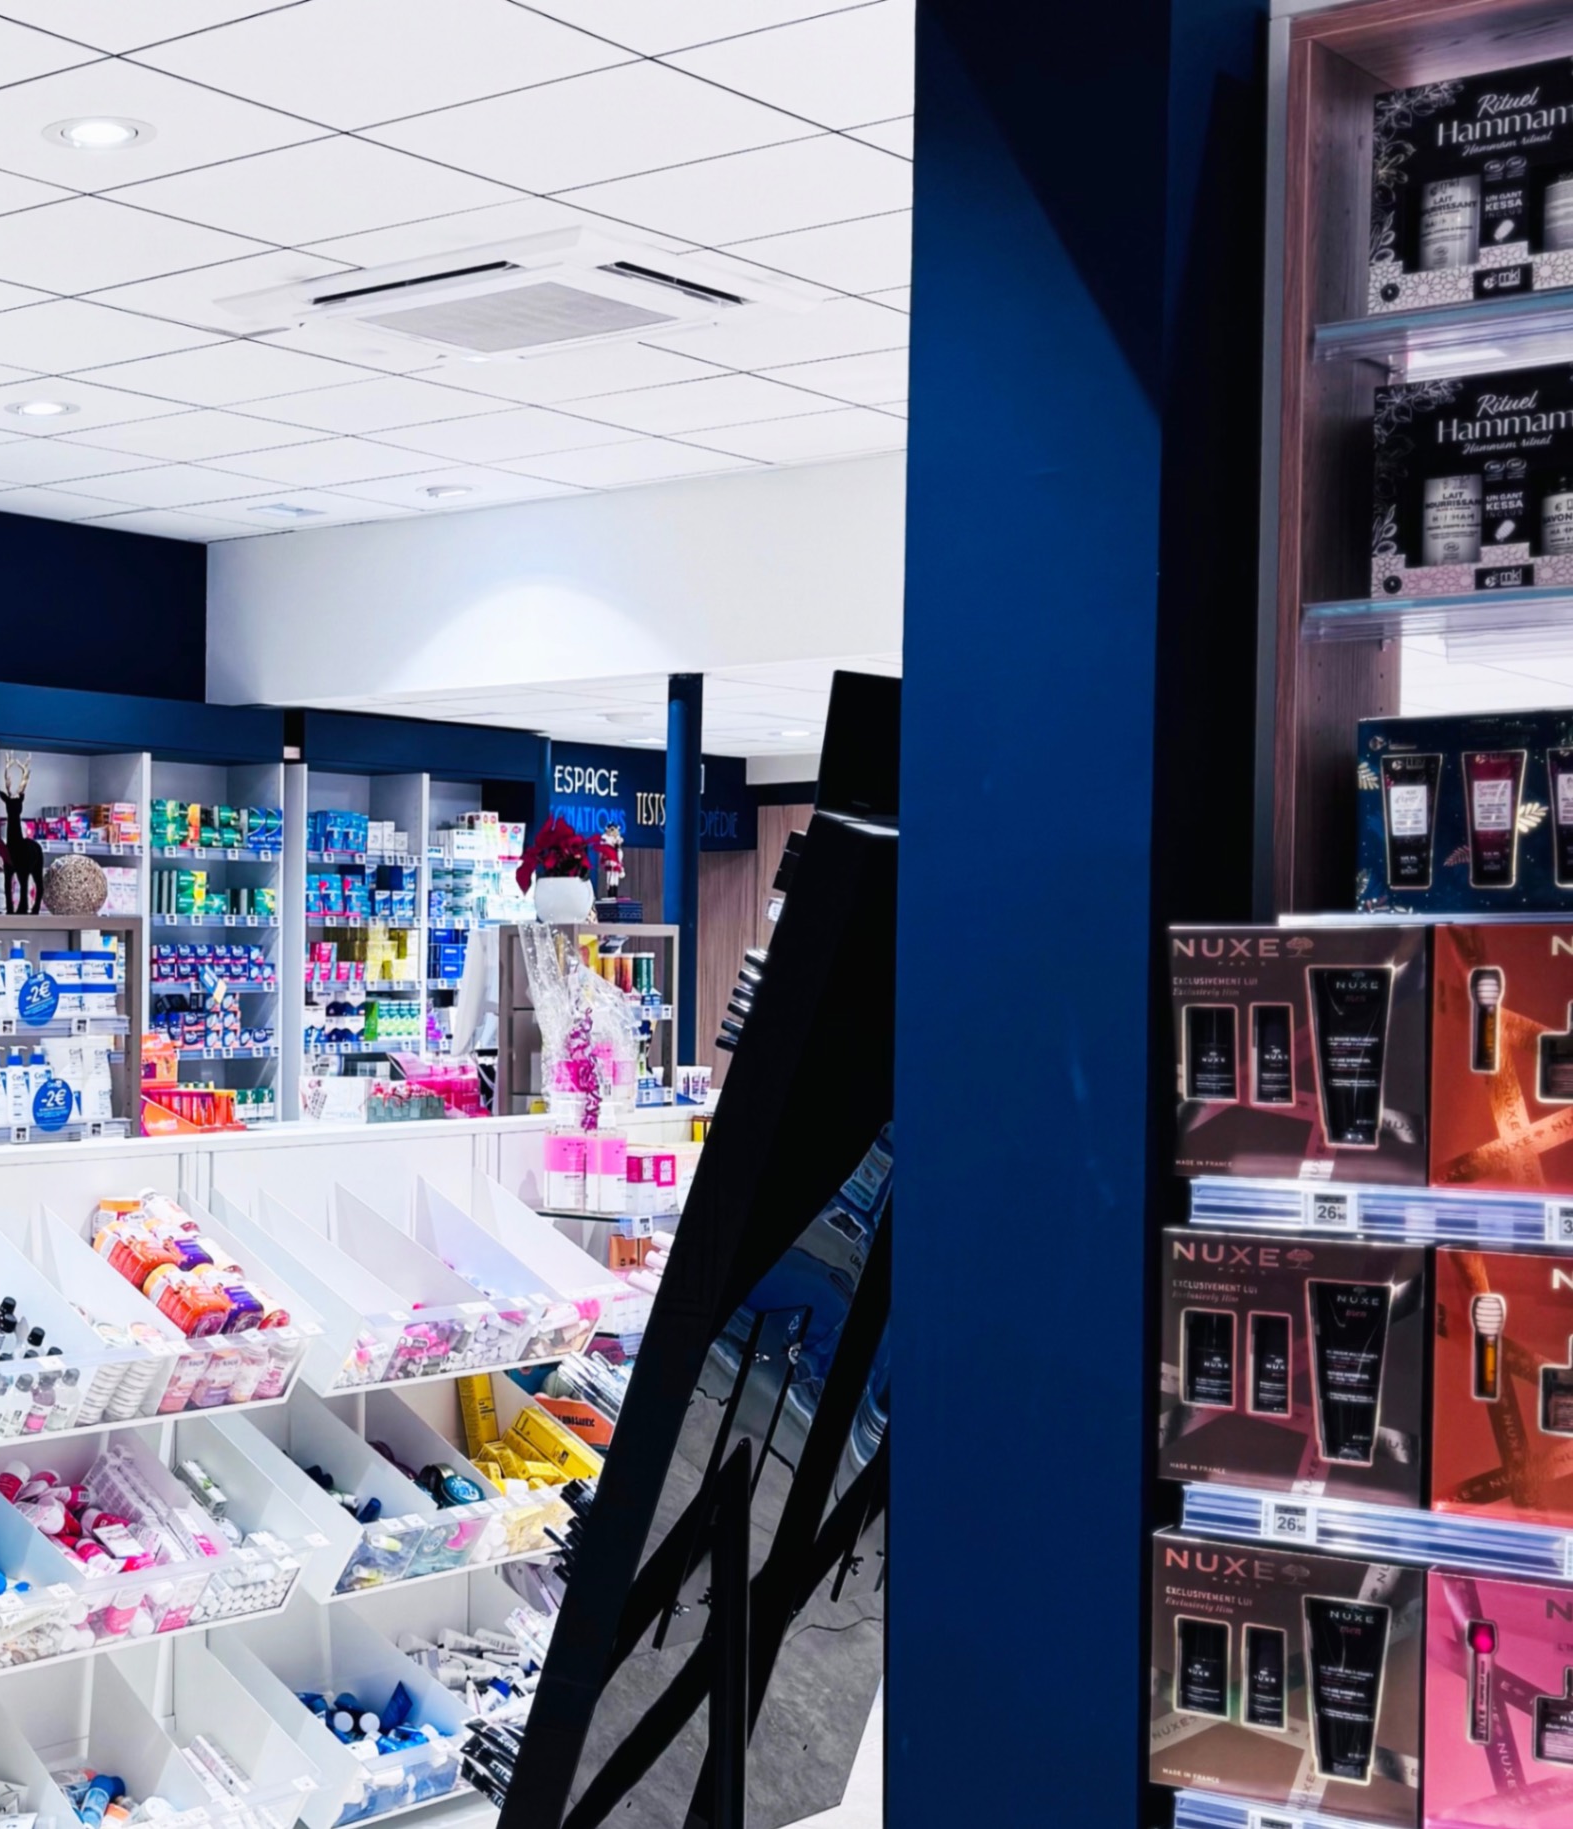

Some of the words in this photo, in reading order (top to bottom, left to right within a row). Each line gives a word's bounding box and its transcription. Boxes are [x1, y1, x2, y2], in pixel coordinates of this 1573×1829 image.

[1477, 86, 1539, 118] Rituel
[1485, 200, 1523, 212] KESSA
[1477, 390, 1539, 417] Rituel
[1485, 500, 1524, 511] KESSA
[554, 765, 619, 796] ESPACE
[636, 792, 666, 826] TESTS
[1173, 938, 1280, 958] NUXE
[1335, 980, 1379, 990] NUXE
[41, 1091, 67, 1112] -2€
[1205, 1160, 1233, 1168] FRANCE
[1173, 1241, 1280, 1267] NUXE
[1173, 1279, 1241, 1293] EXCLUSIVEMENT
[1337, 1295, 1379, 1306] NUXE
[1170, 1462, 1189, 1470] MADE
[1199, 1466, 1226, 1475] FRANCE
[1165, 1548, 1275, 1581] NUXE
[1165, 1586, 1235, 1605] EXCLUSIVEMENT
[1329, 1610, 1375, 1624] NUXE
[1163, 1768, 1182, 1777] MADE
[1193, 1773, 1220, 1784] FRANCE
